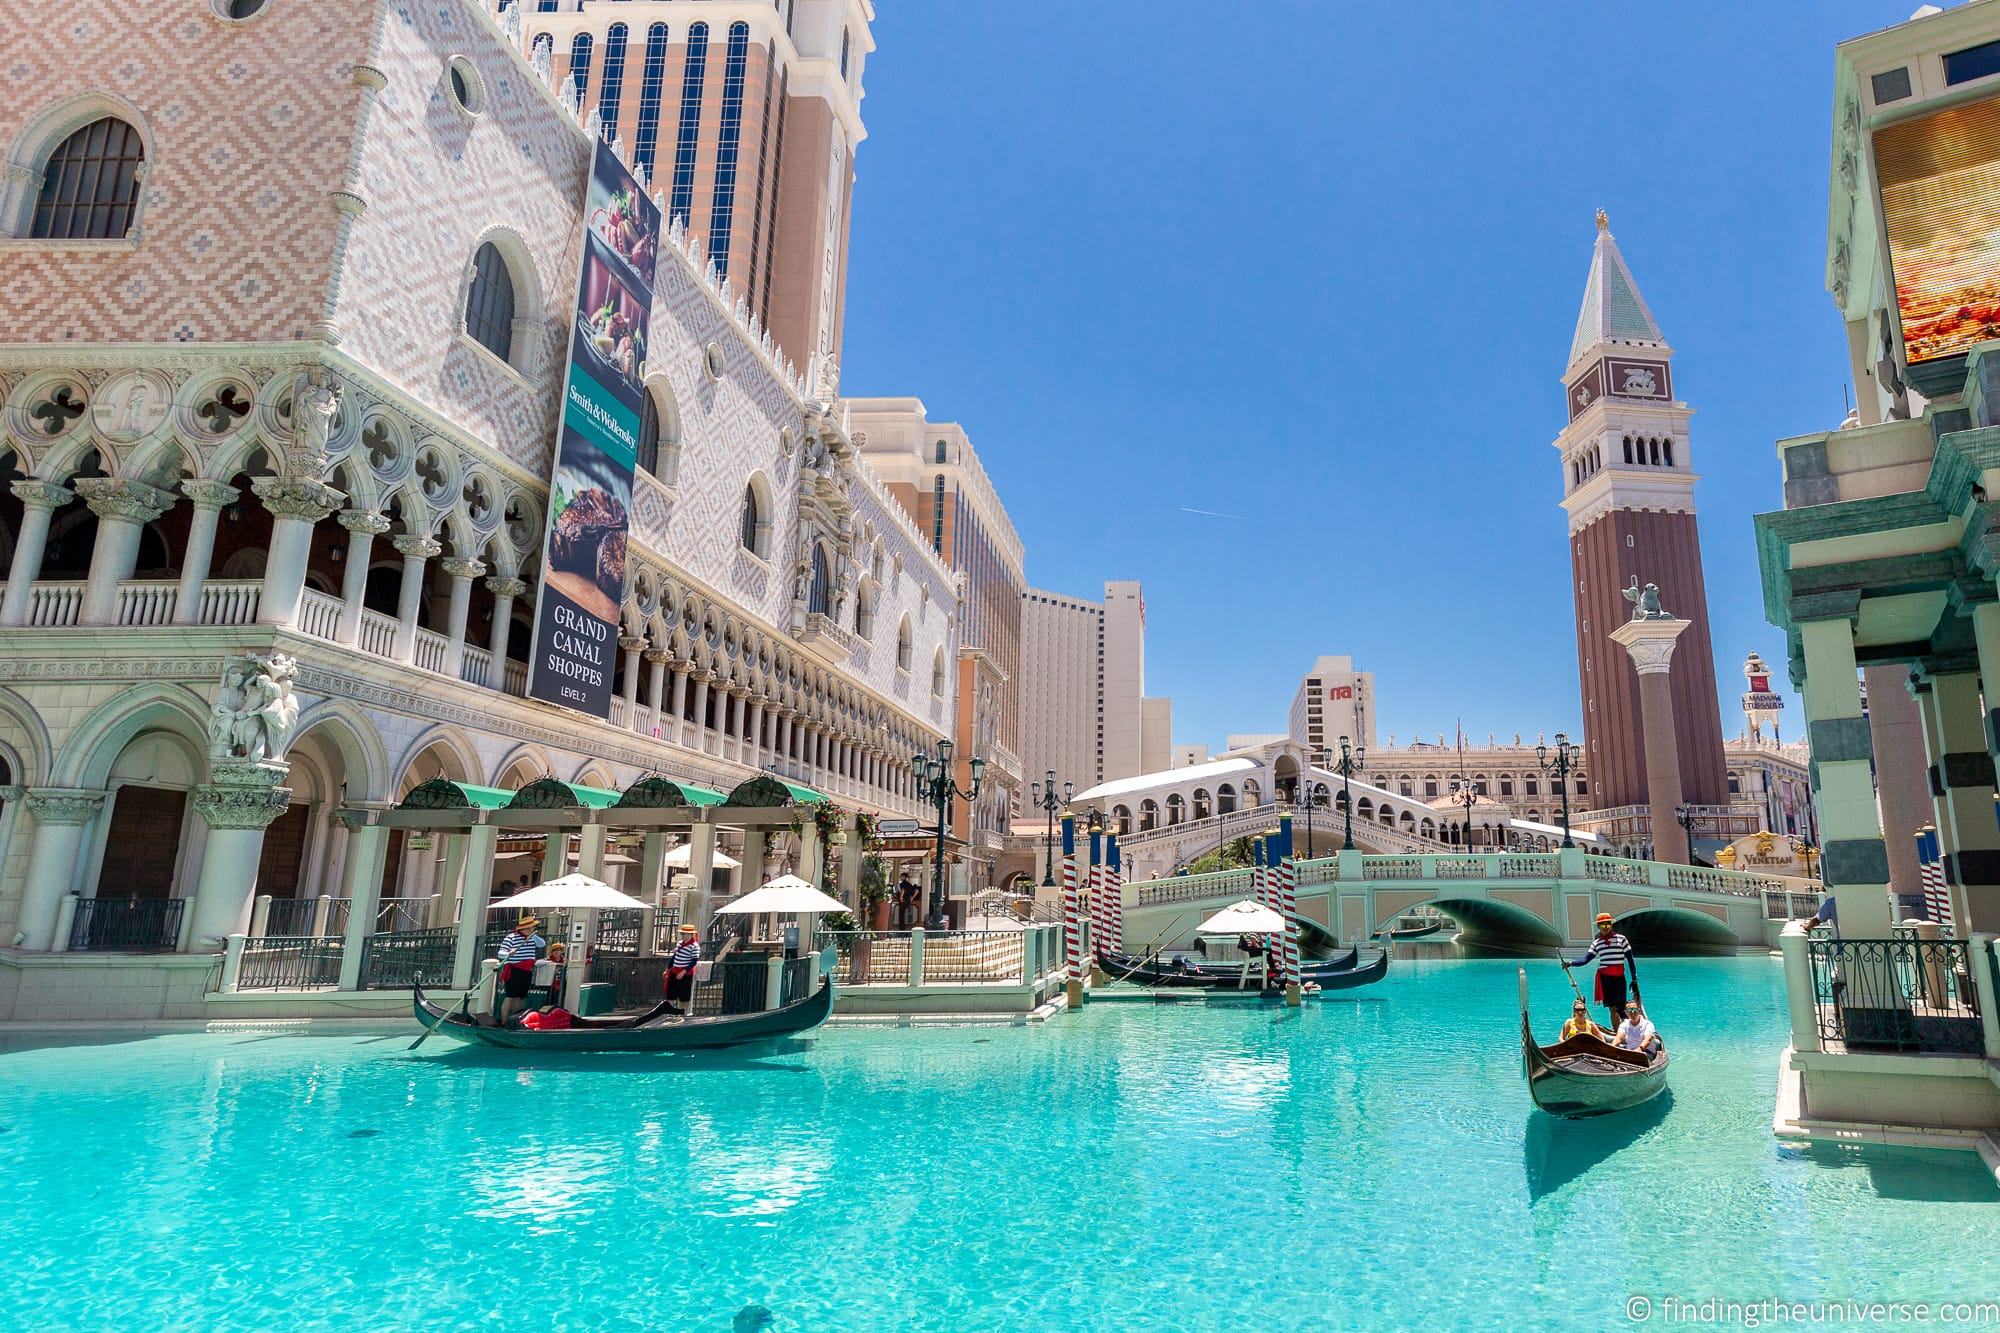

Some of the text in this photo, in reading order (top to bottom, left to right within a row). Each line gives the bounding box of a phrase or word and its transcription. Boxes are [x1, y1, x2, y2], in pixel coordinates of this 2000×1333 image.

[569, 384, 636, 449] Smith & Wollensky
[554, 605, 607, 642] GRAND
[553, 630, 602, 666] CANAL
[548, 654, 602, 687] SHOPPES
[560, 685, 587, 703] LEVEL 2
